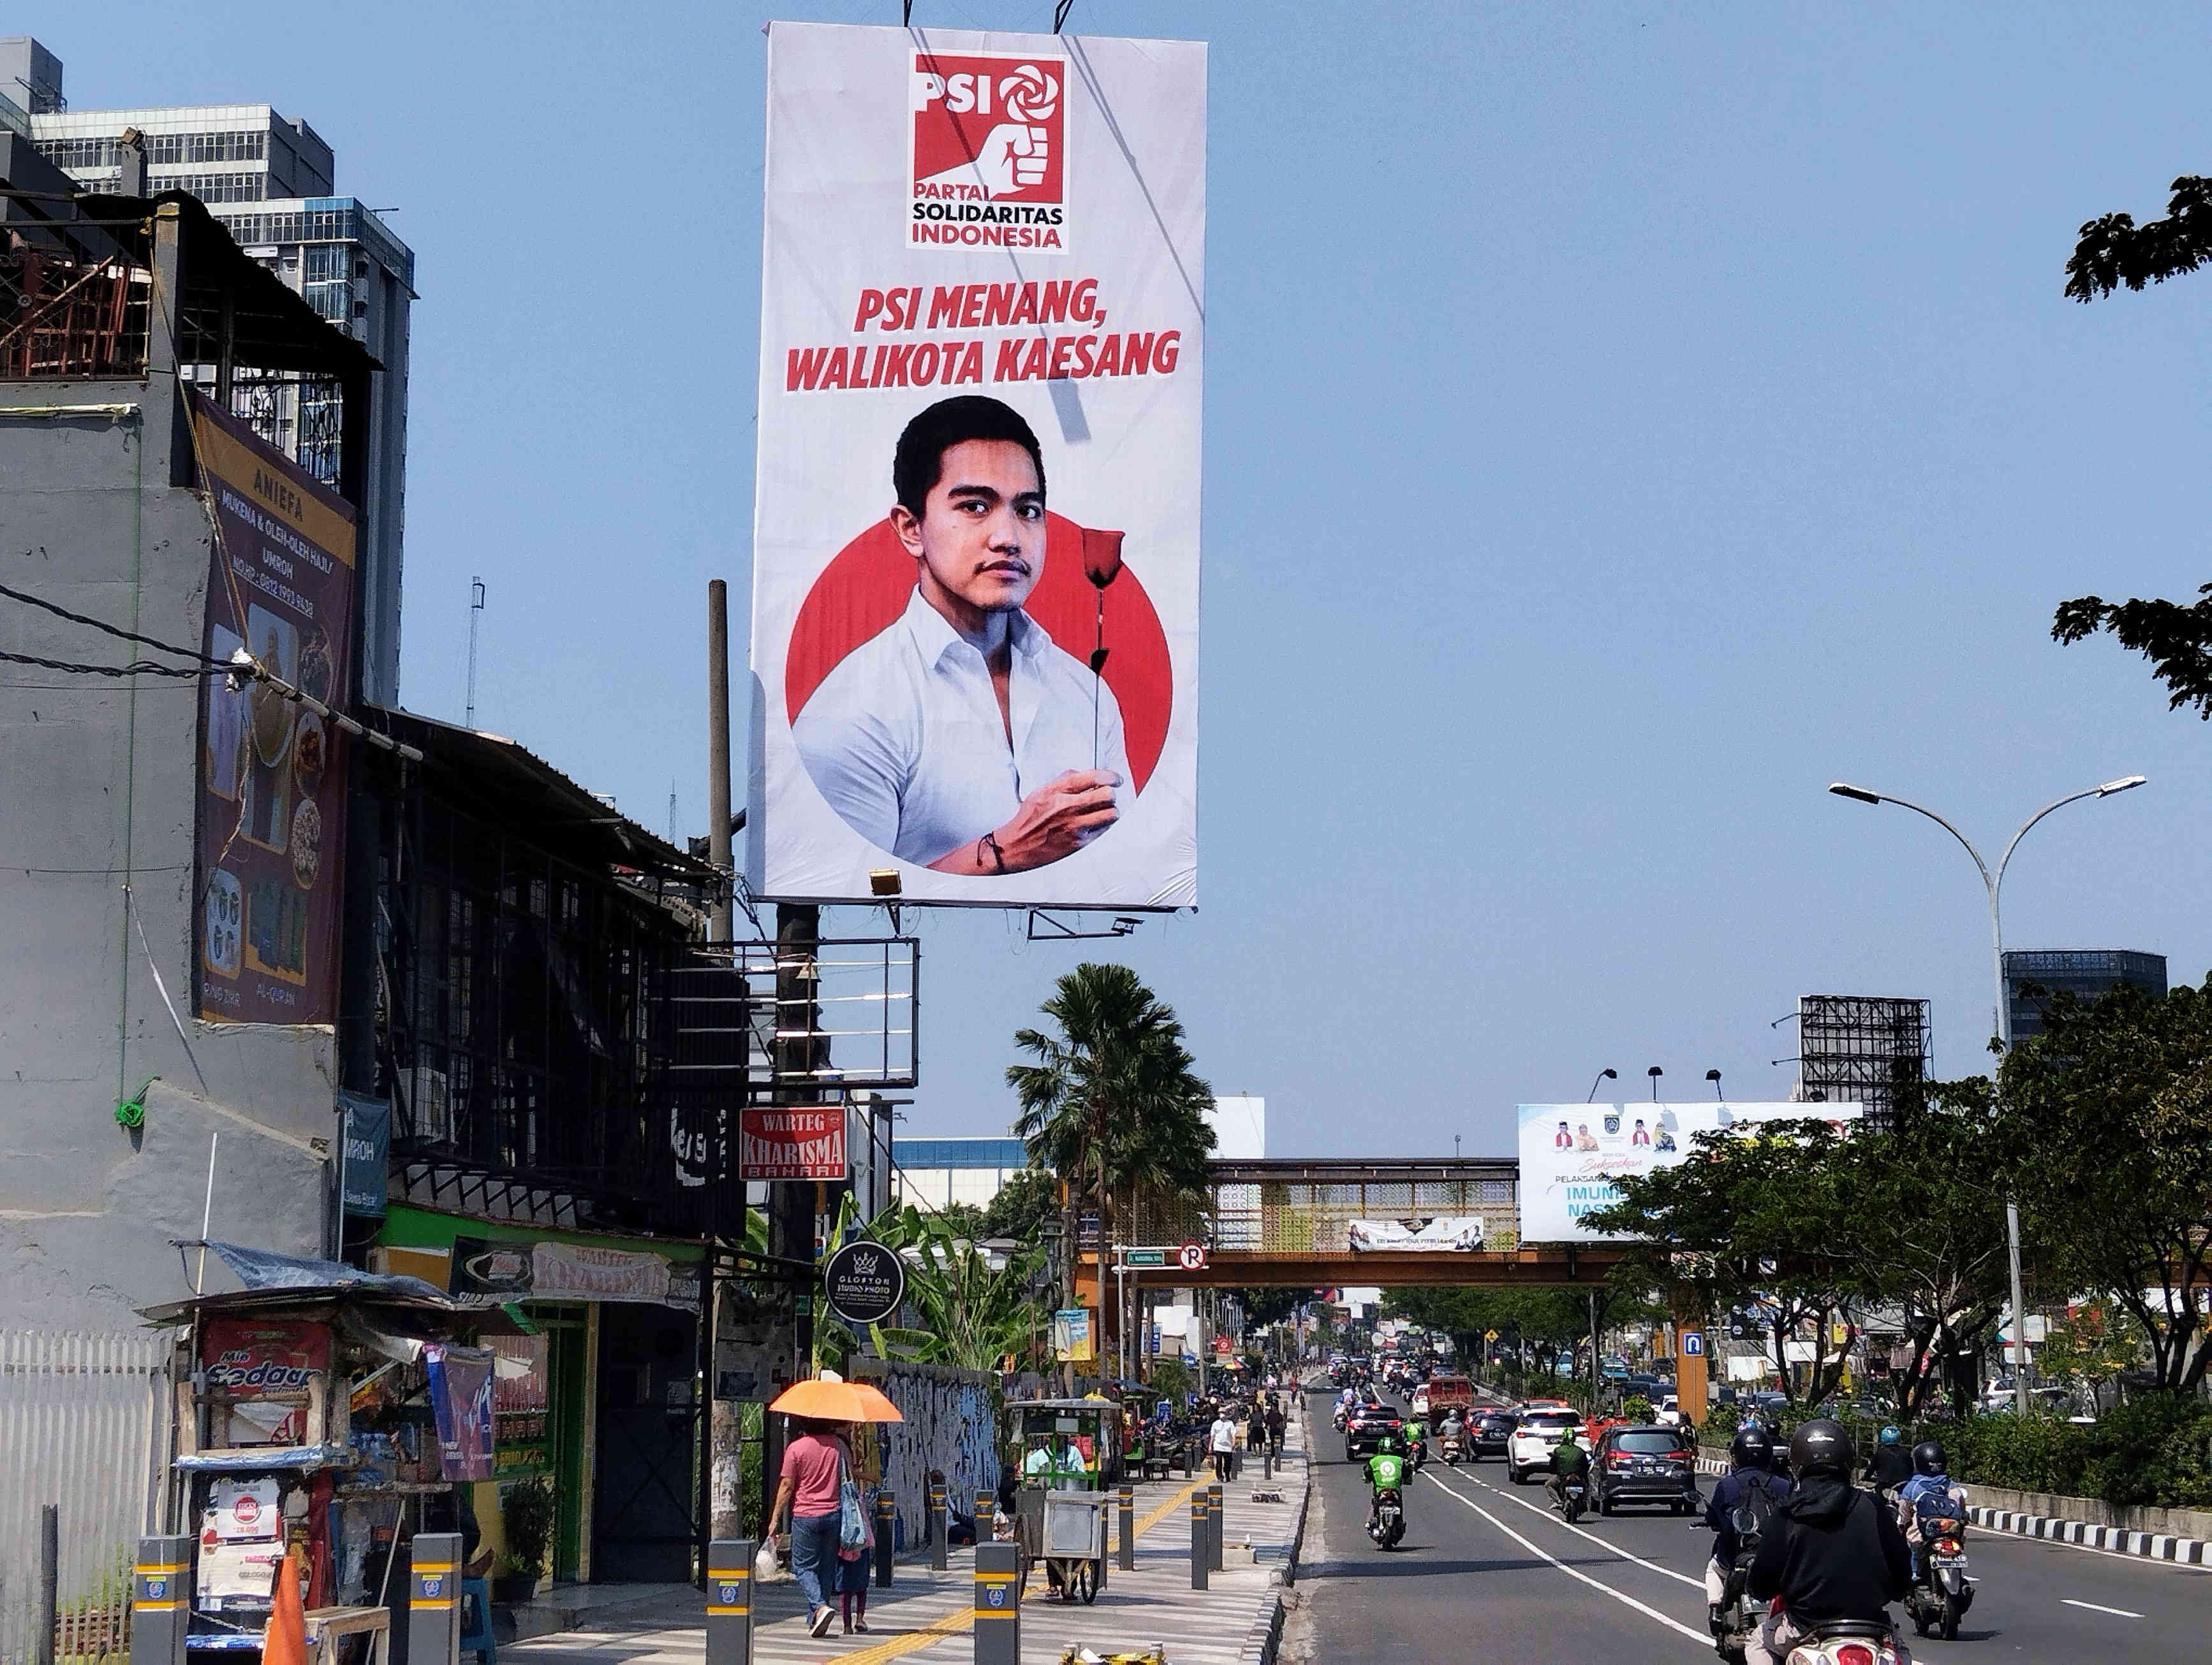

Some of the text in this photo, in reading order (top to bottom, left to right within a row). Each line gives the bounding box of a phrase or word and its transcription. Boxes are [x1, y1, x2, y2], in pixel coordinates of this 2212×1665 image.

[916, 73, 991, 114] PSI
[913, 182, 990, 201] PARTAI
[913, 203, 1063, 224] SOLIDARITAS
[912, 224, 1062, 248] INDONESIA
[854, 278, 1107, 332] PSI MENANG,
[786, 330, 1181, 392] WALIKOTA KAESANG
[762, 1114, 825, 1131] WARTEG
[743, 1129, 843, 1164] KHARISMA
[748, 1166, 839, 1177] BAHARI
